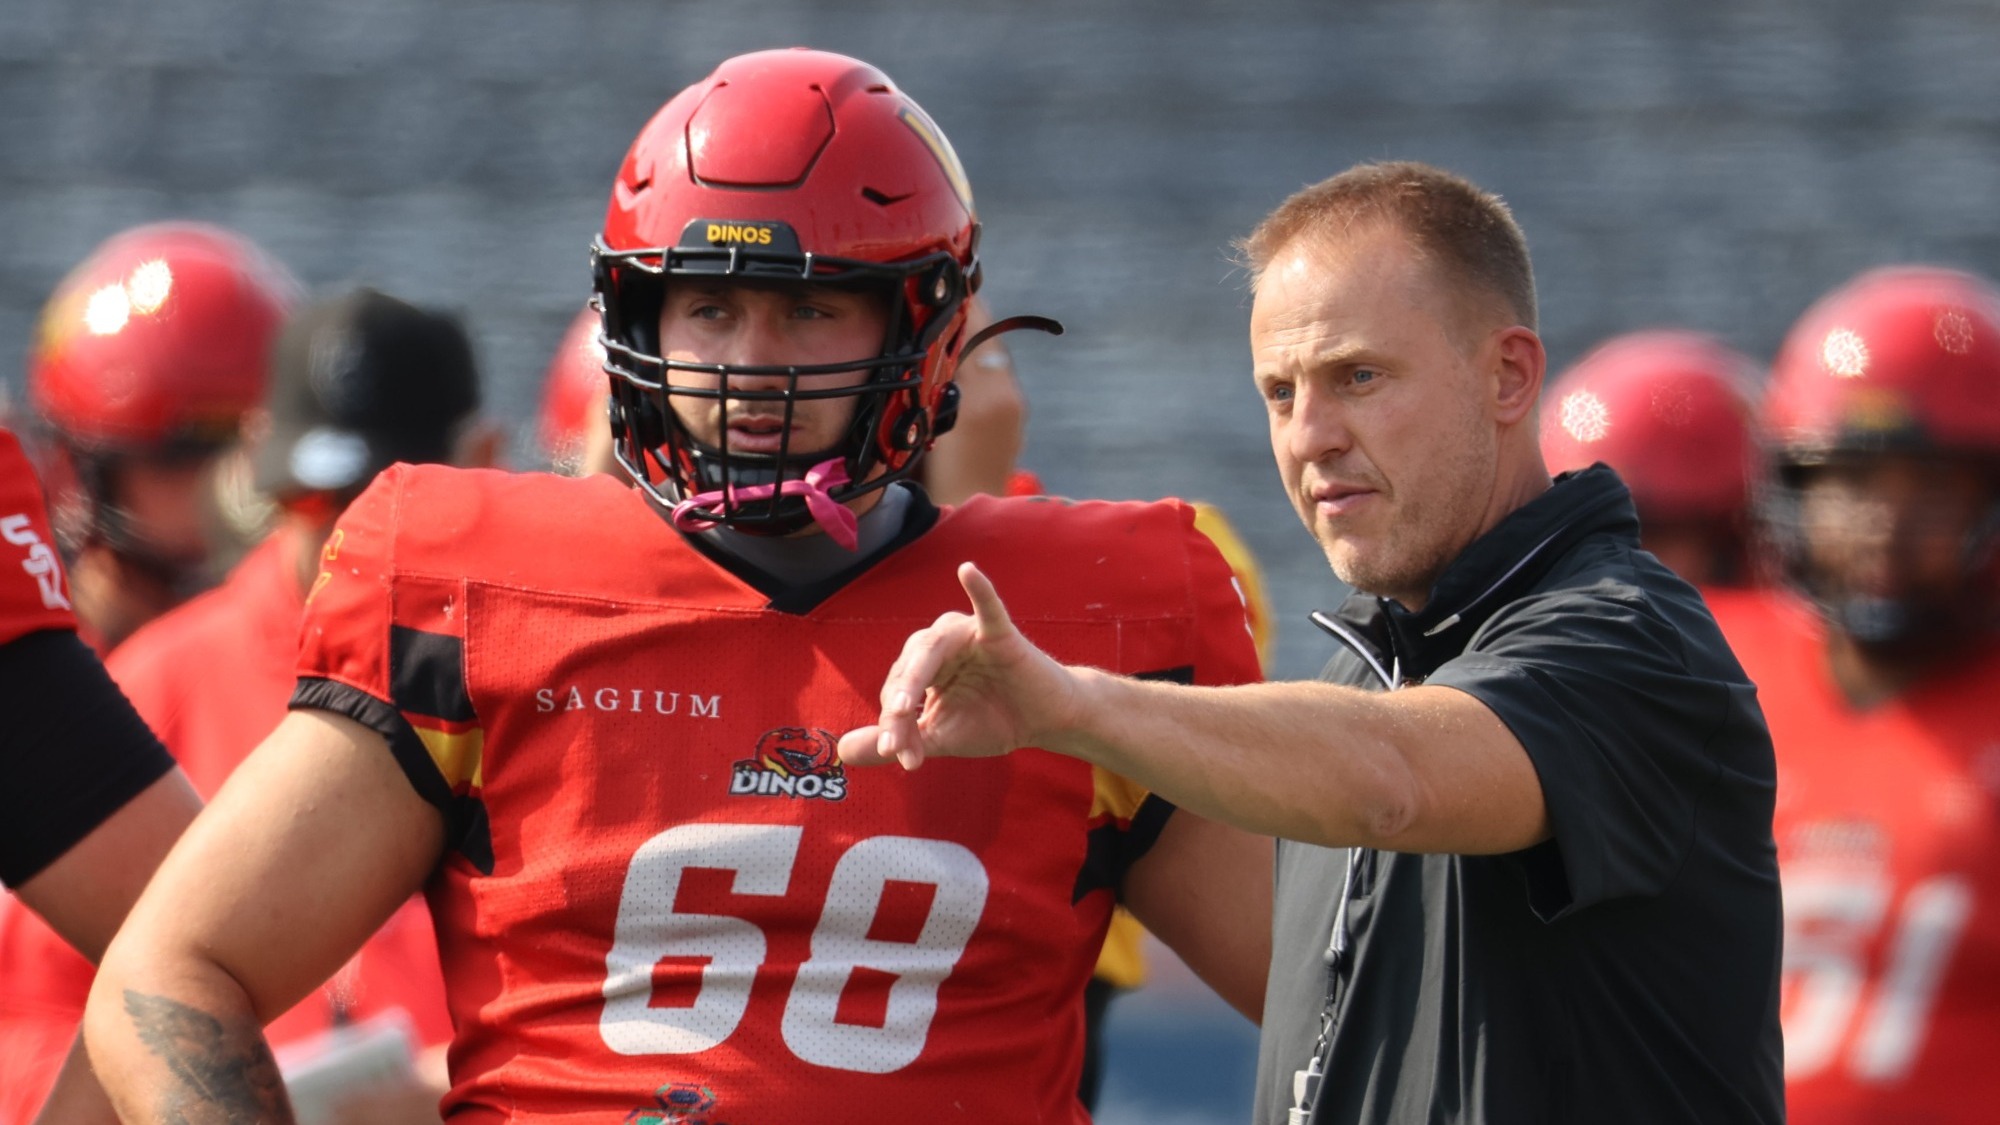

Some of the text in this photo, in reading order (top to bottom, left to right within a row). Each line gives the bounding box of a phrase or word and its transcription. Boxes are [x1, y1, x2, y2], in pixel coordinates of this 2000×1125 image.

[706, 224, 772, 245] DINOS
[536, 685, 721, 718] SAGIUM
[730, 769, 846, 801] DINOS
[599, 823, 990, 1074] 68
